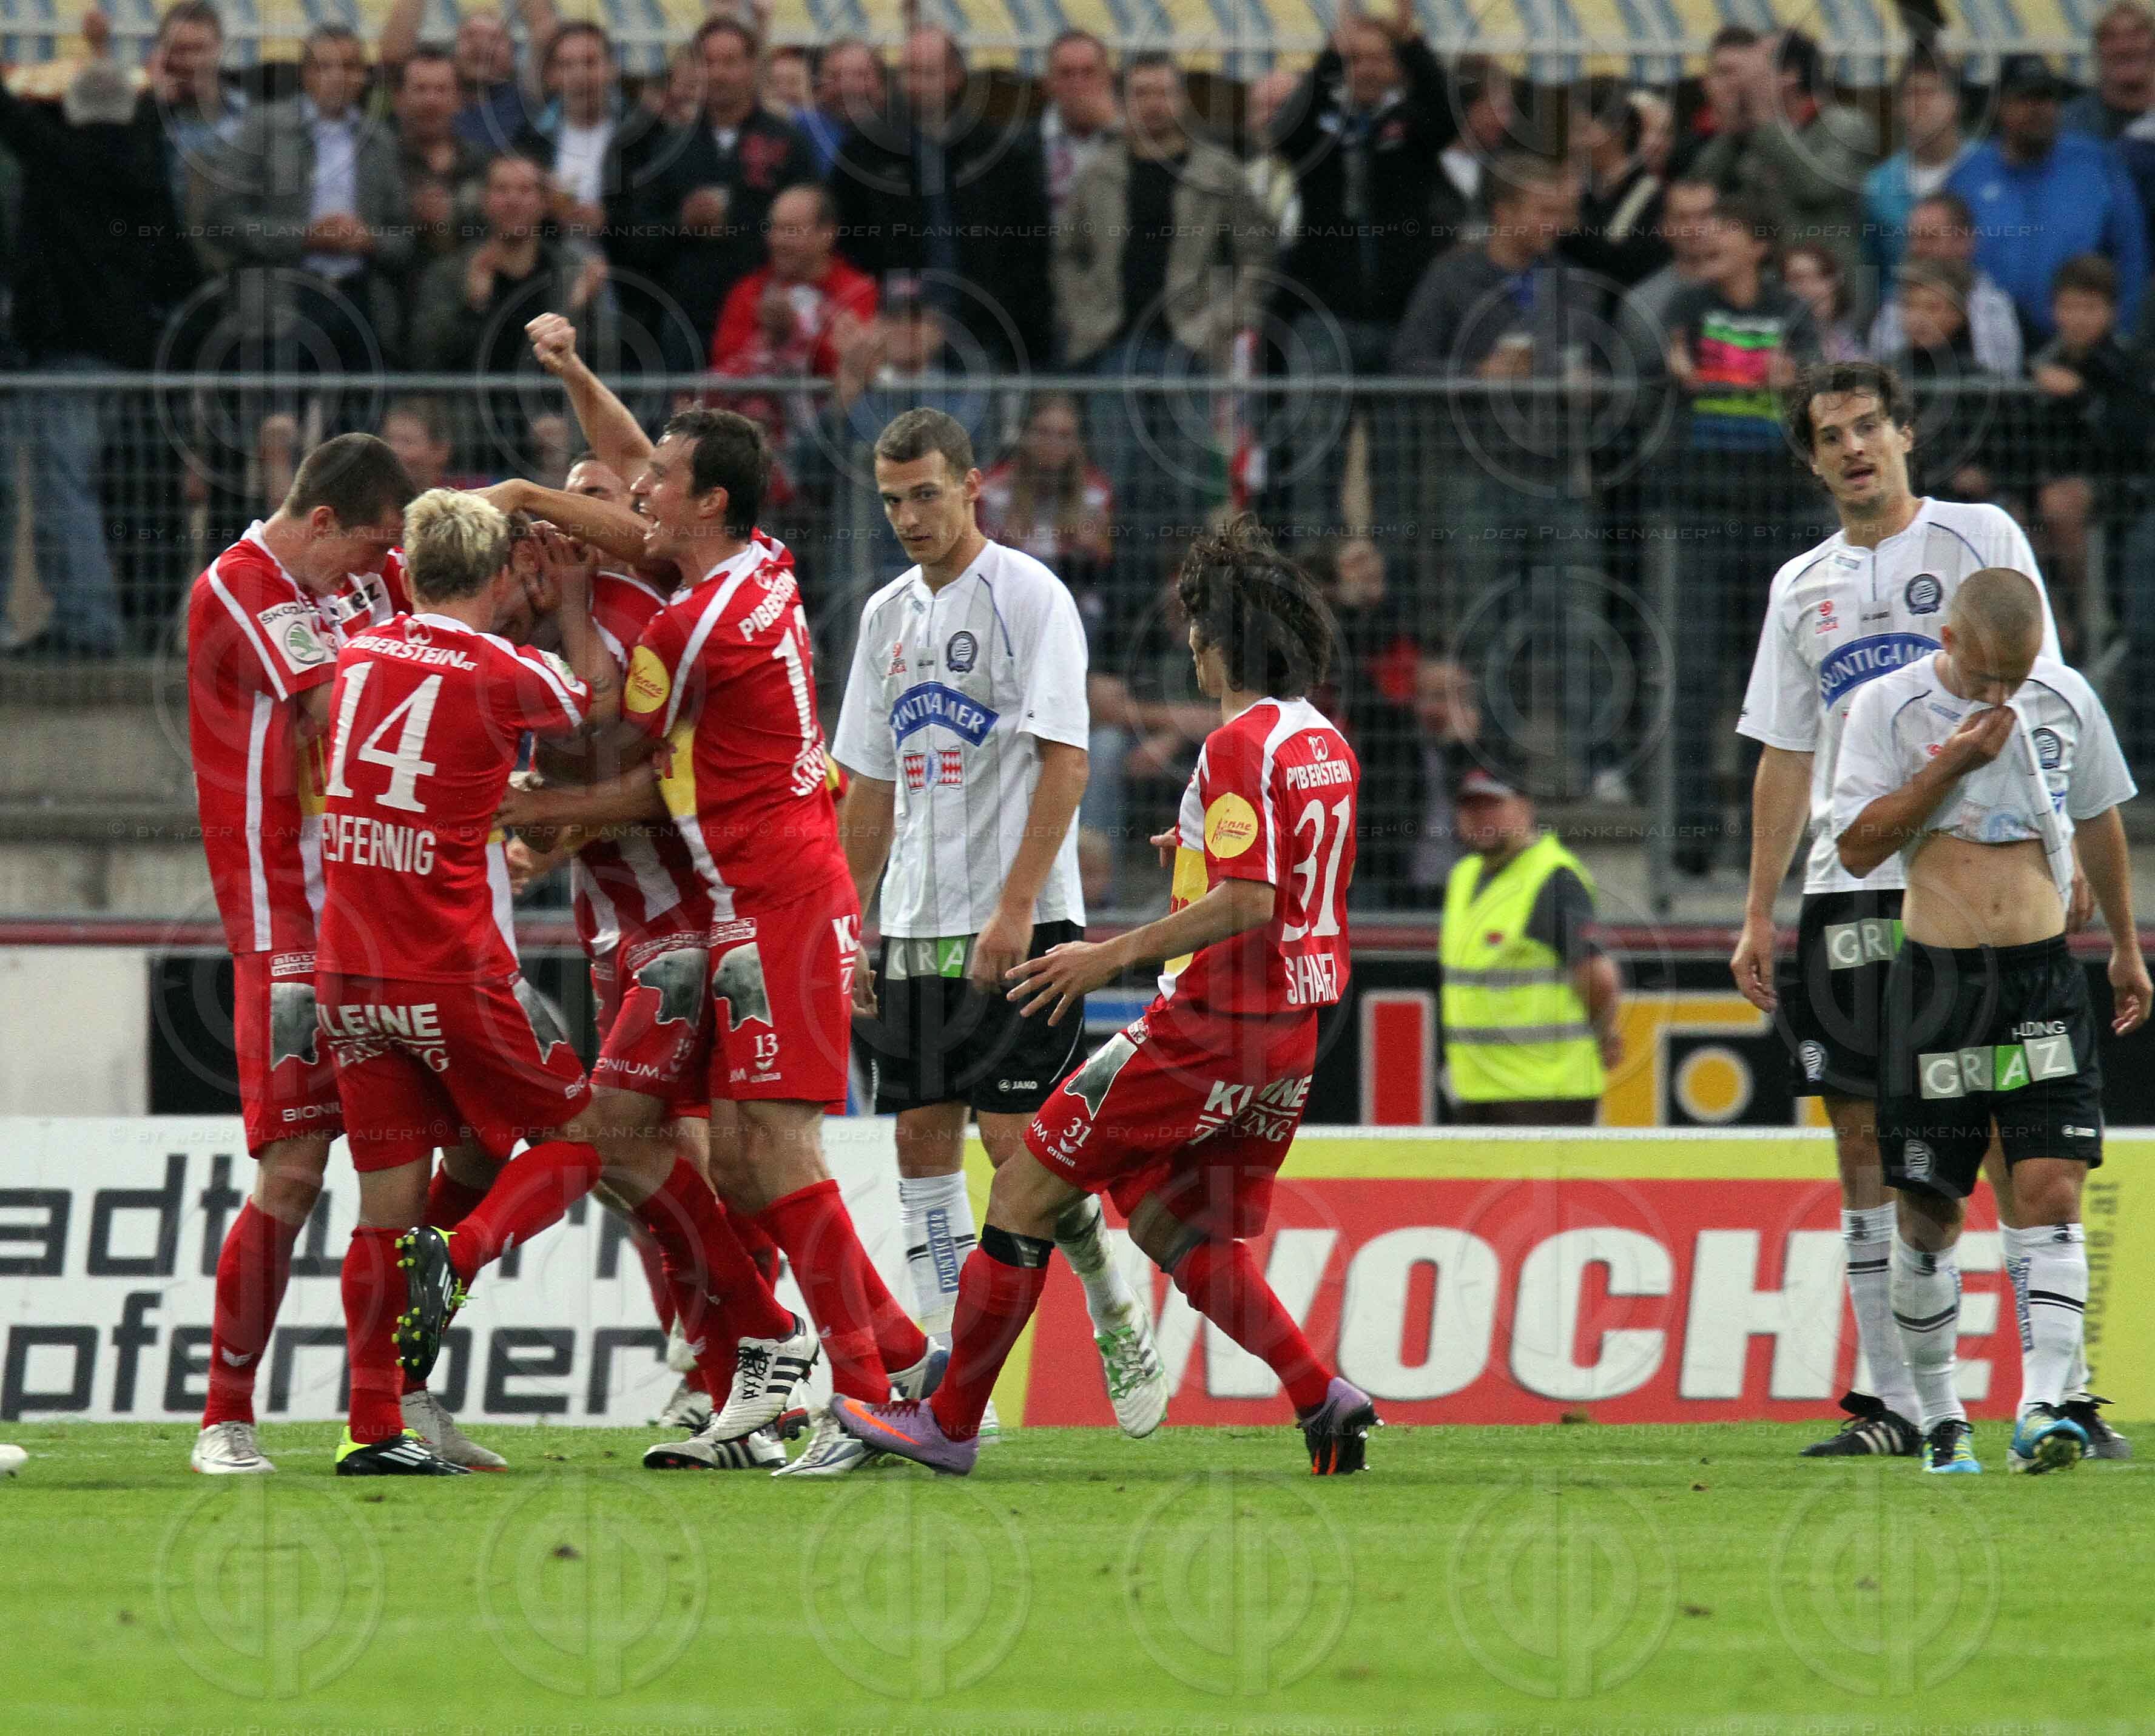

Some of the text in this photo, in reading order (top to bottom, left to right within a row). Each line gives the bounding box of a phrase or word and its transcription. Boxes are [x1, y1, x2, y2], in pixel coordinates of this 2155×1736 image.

[326, 661, 443, 813] 14
[1286, 759, 1352, 791] PIBERSTEIN
[1281, 794, 1351, 942] 31
[317, 1003, 442, 1037] LEINE
[754, 1033, 780, 1058] 13
[1924, 1040, 2069, 1094] GRAZ
[1011, 1080, 1038, 1090] JAKO
[1063, 1117, 1092, 1148] 31
